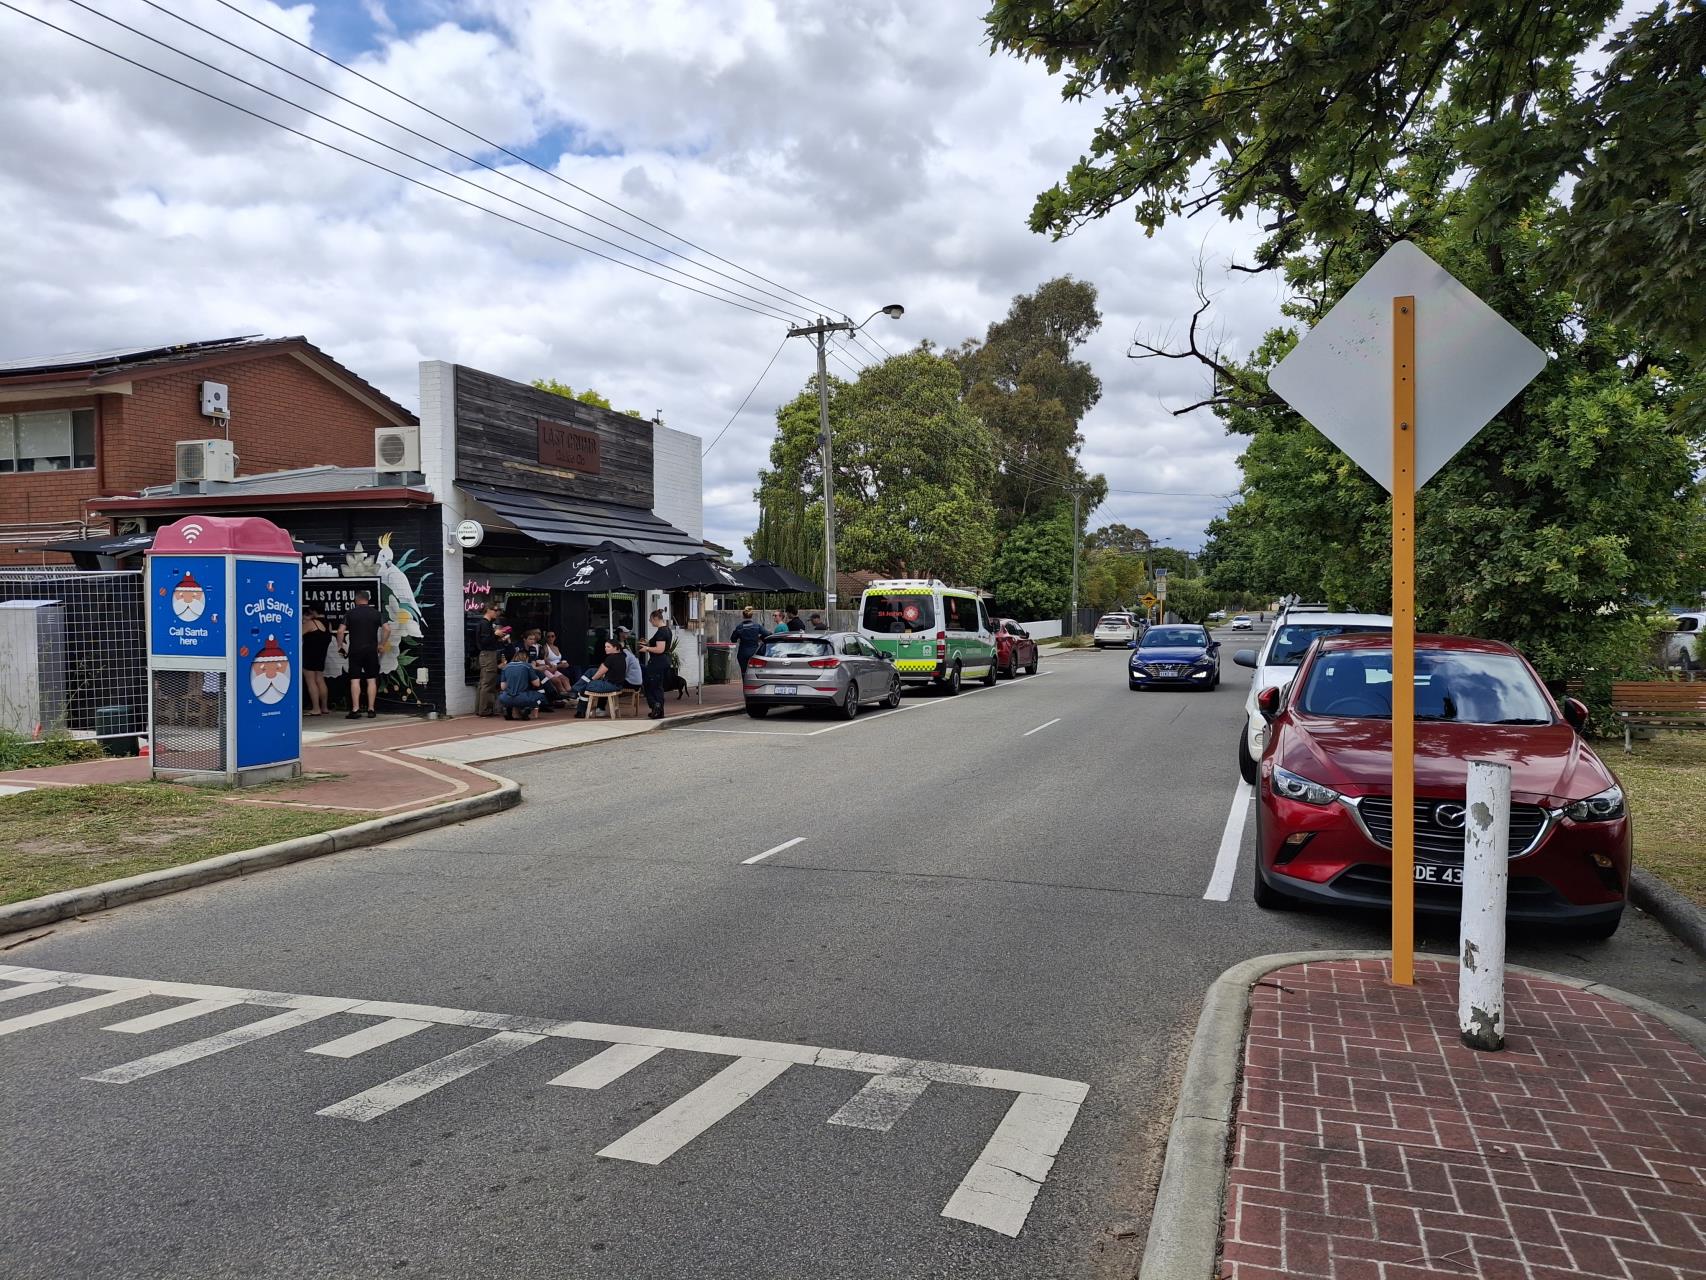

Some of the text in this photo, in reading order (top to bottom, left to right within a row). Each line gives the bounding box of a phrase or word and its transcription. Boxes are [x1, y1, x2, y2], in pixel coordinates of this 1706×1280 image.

[305, 590, 332, 601] LAST
[244, 597, 294, 618] Call Santa
[324, 602, 341, 611] AKE
[465, 597, 479, 611] Cake
[258, 612, 282, 624] here
[169, 626, 208, 636] Call Santa
[179, 636, 198, 646] here
[1413, 865, 1463, 883] DE 43
